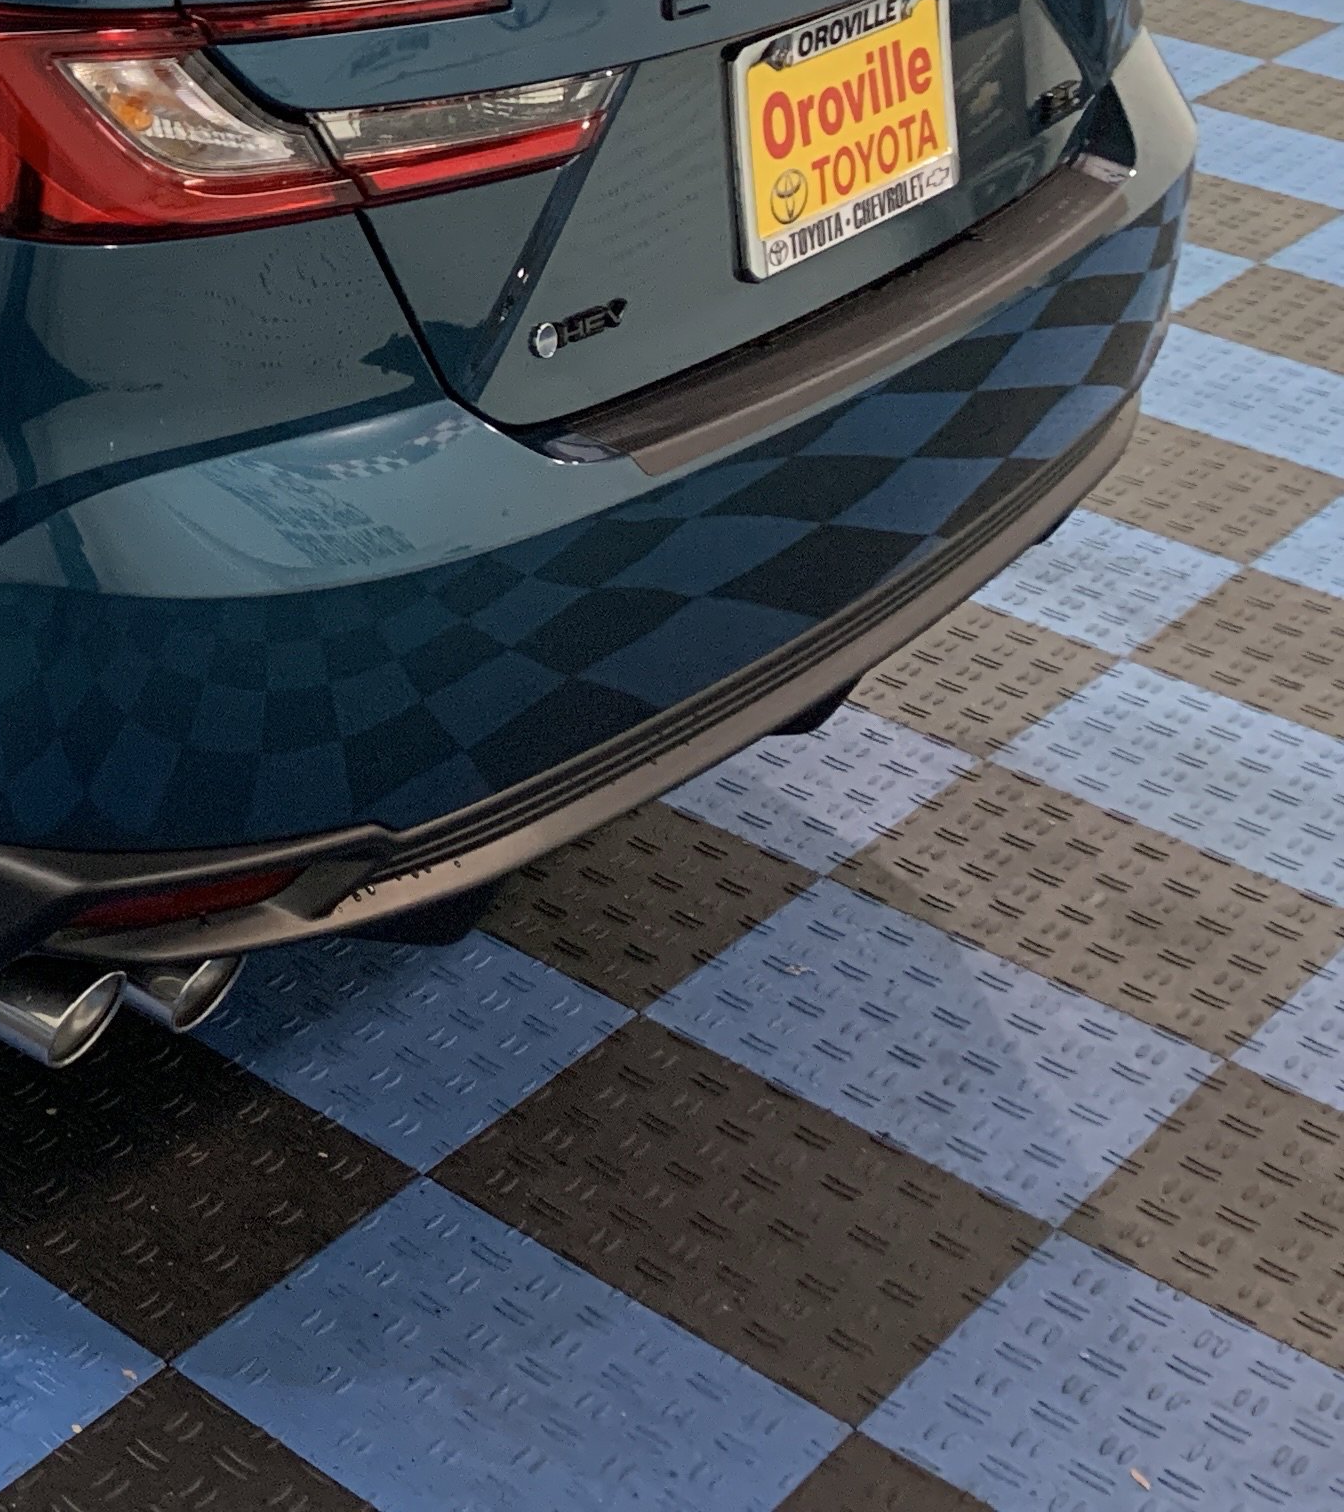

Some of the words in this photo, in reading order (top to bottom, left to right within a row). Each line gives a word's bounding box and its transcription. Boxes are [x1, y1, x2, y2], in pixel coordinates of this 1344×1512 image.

[762, 39, 932, 160] Oroville
[812, 108, 939, 206] TOYOTA
[788, 216, 844, 260] TOYOTA
[852, 171, 925, 231] CHEVROLET
